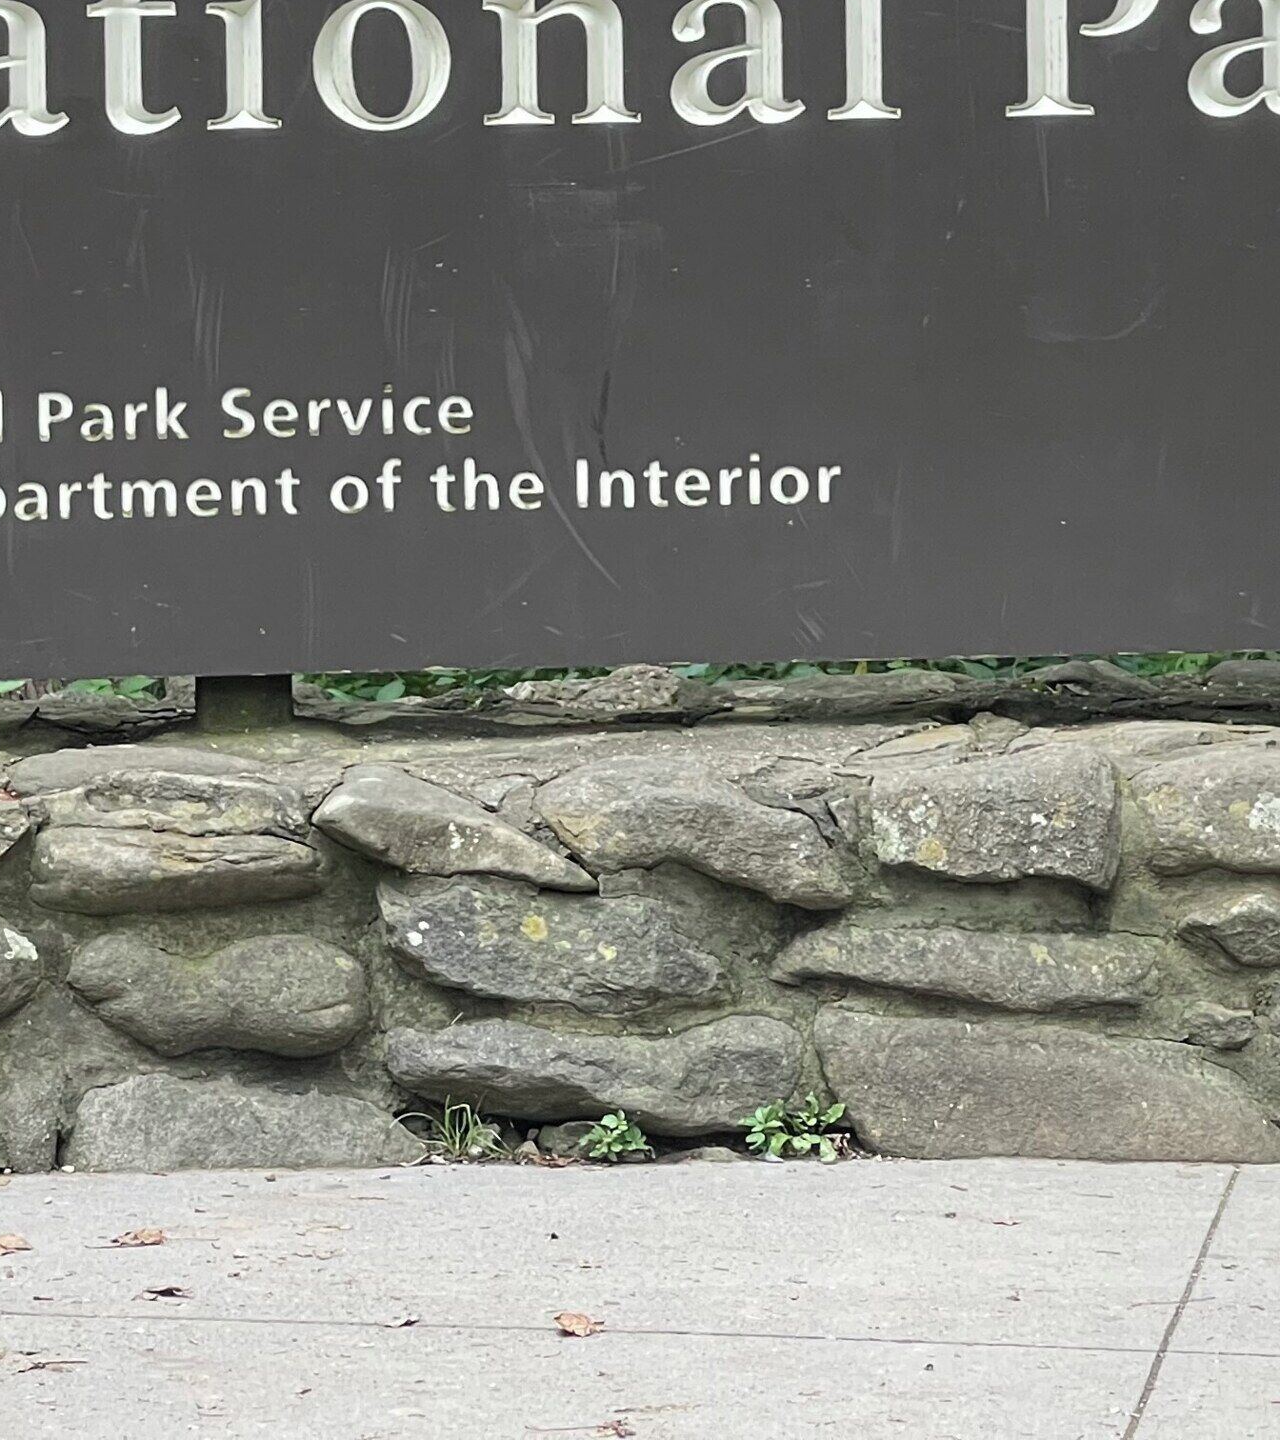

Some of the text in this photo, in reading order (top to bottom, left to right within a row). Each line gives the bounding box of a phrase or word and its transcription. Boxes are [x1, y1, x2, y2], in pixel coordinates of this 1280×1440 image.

[36, 385, 191, 444] Park
[219, 382, 476, 441] Service
[327, 456, 404, 515] of
[427, 455, 546, 513] the
[574, 450, 843, 511] Interior
